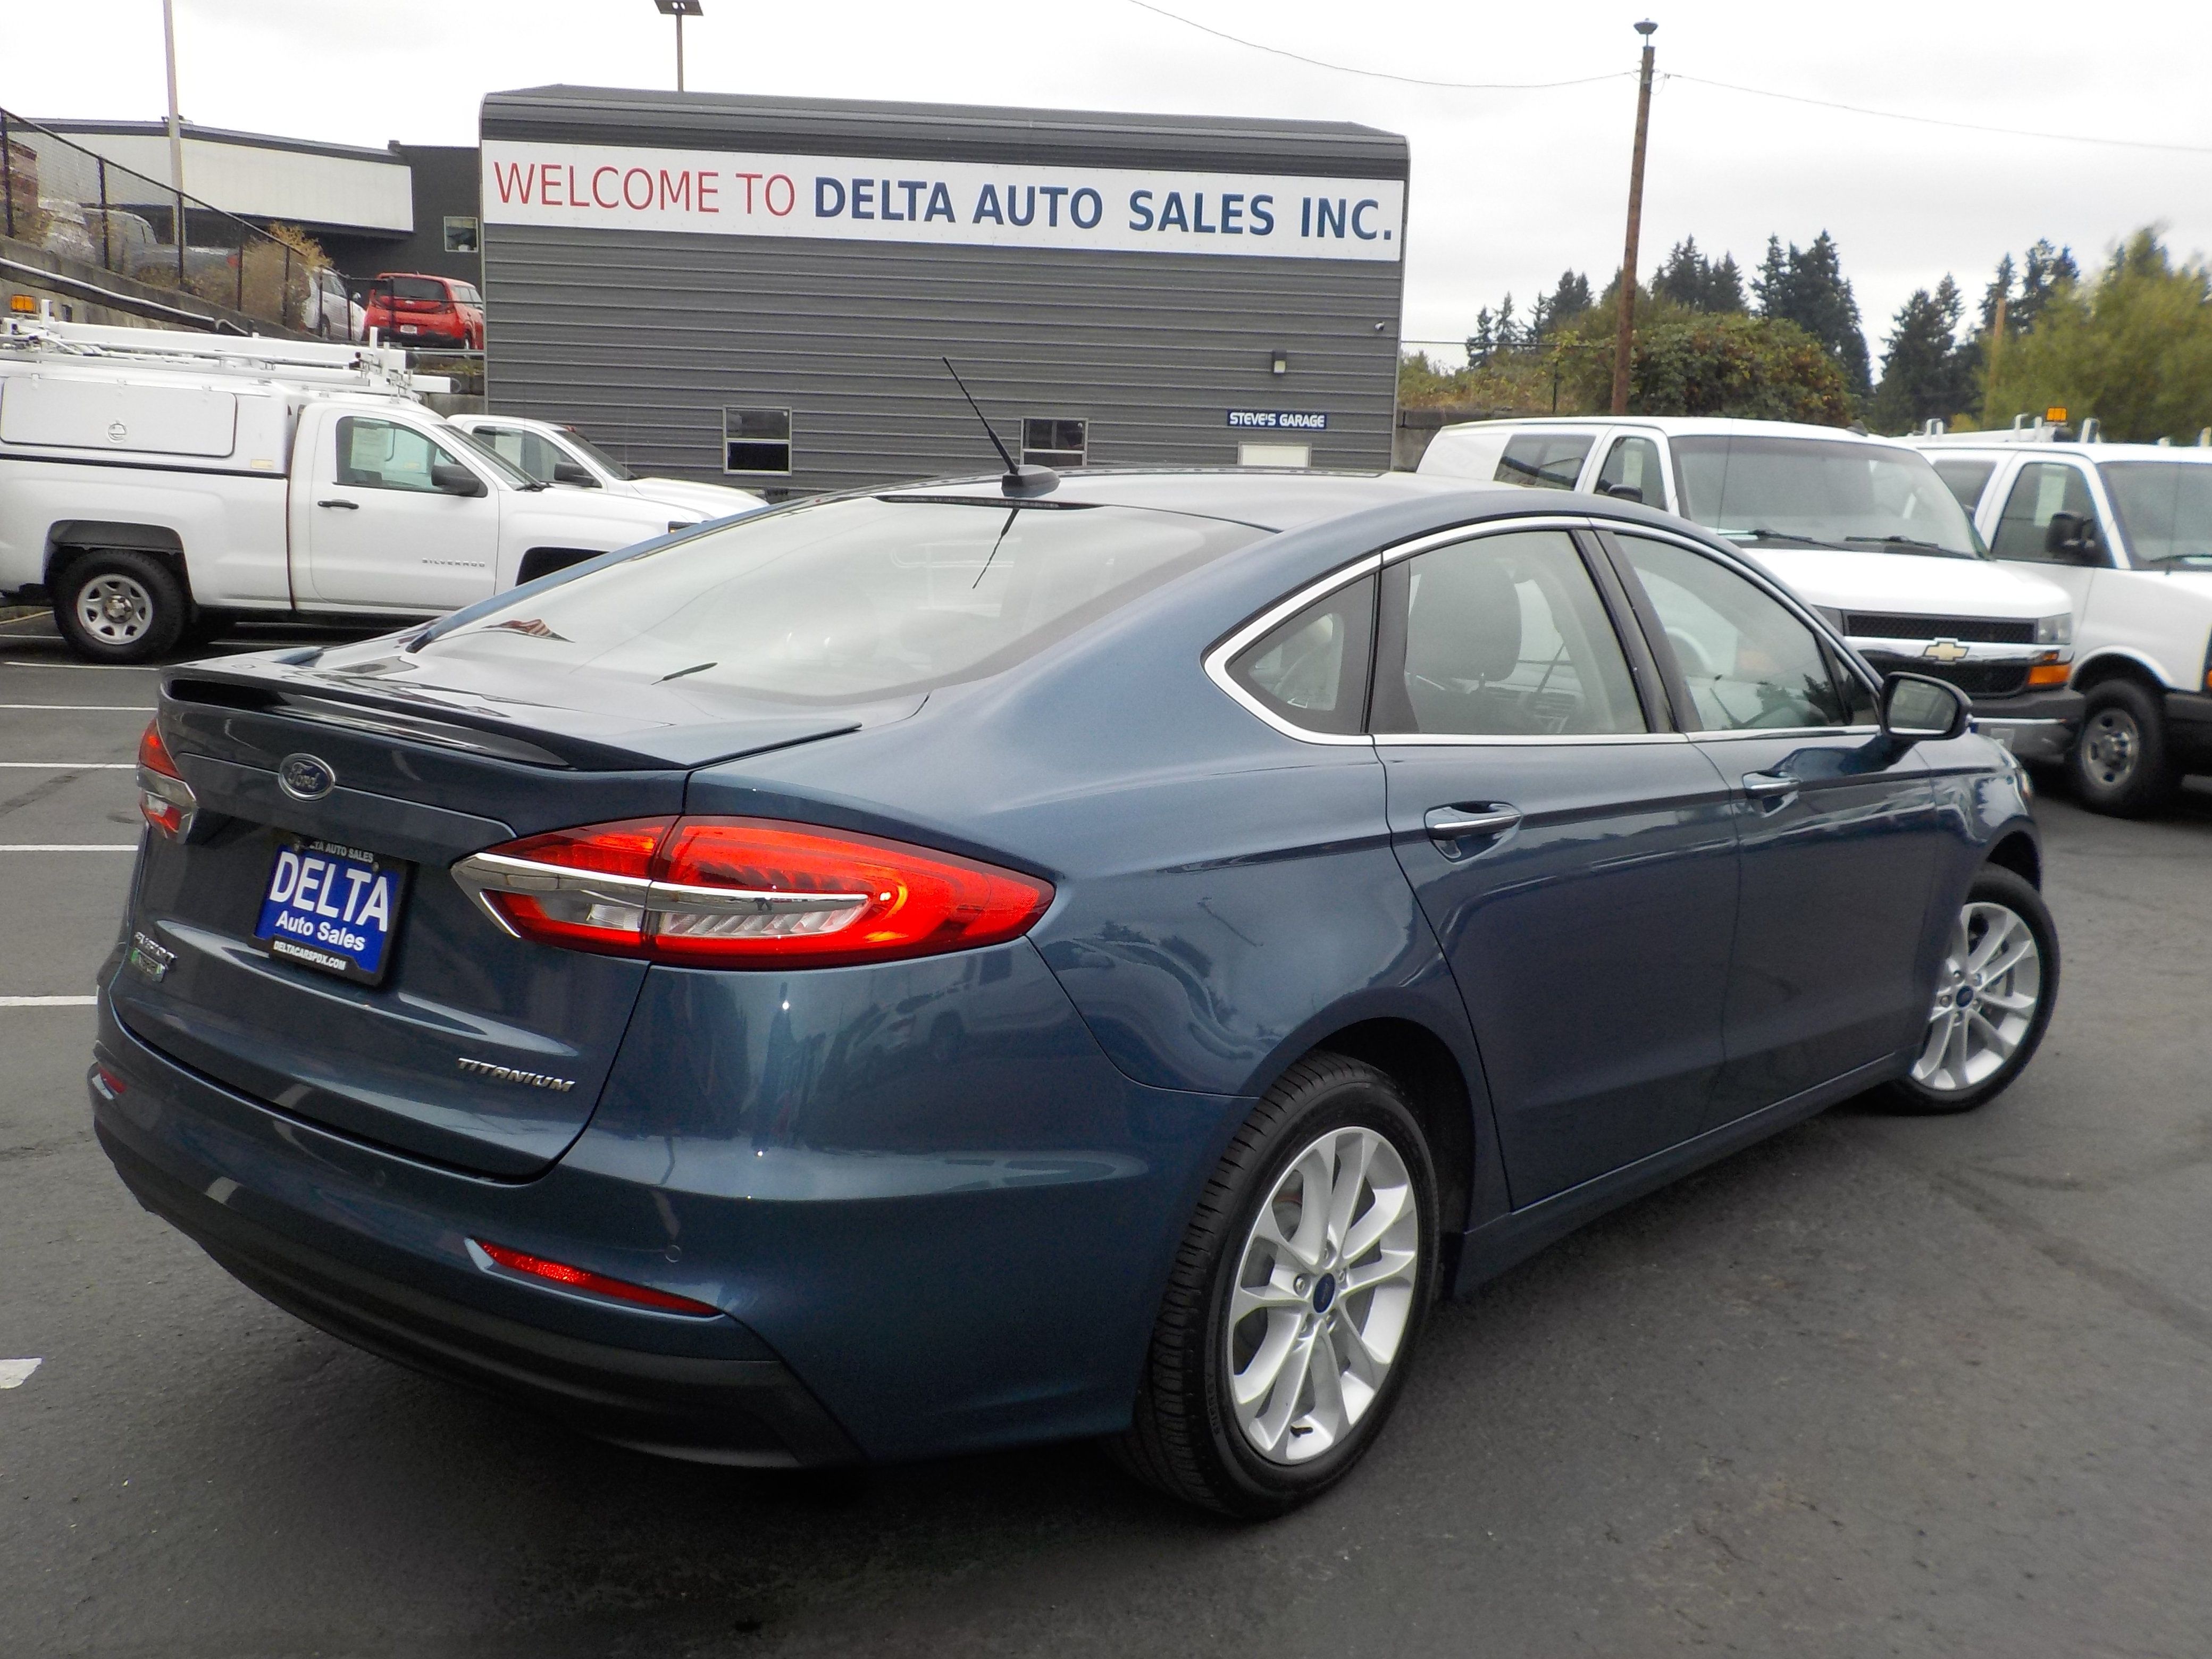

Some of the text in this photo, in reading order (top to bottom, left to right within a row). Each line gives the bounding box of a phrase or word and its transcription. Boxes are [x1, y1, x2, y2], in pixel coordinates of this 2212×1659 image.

[493, 162, 1392, 240] WELCOME TO DELTA AUTO SALES INC.
[1229, 412, 1325, 428] STEVE'S GARAGE
[288, 761, 320, 789] Ford
[325, 842, 347, 857] AUTO
[348, 848, 374, 863] SALES
[269, 851, 388, 932] DELTA
[275, 910, 366, 951] Auto Sales
[273, 940, 347, 971] DELTACARSPDX.COM
[458, 1057, 576, 1092] TITANIUM
